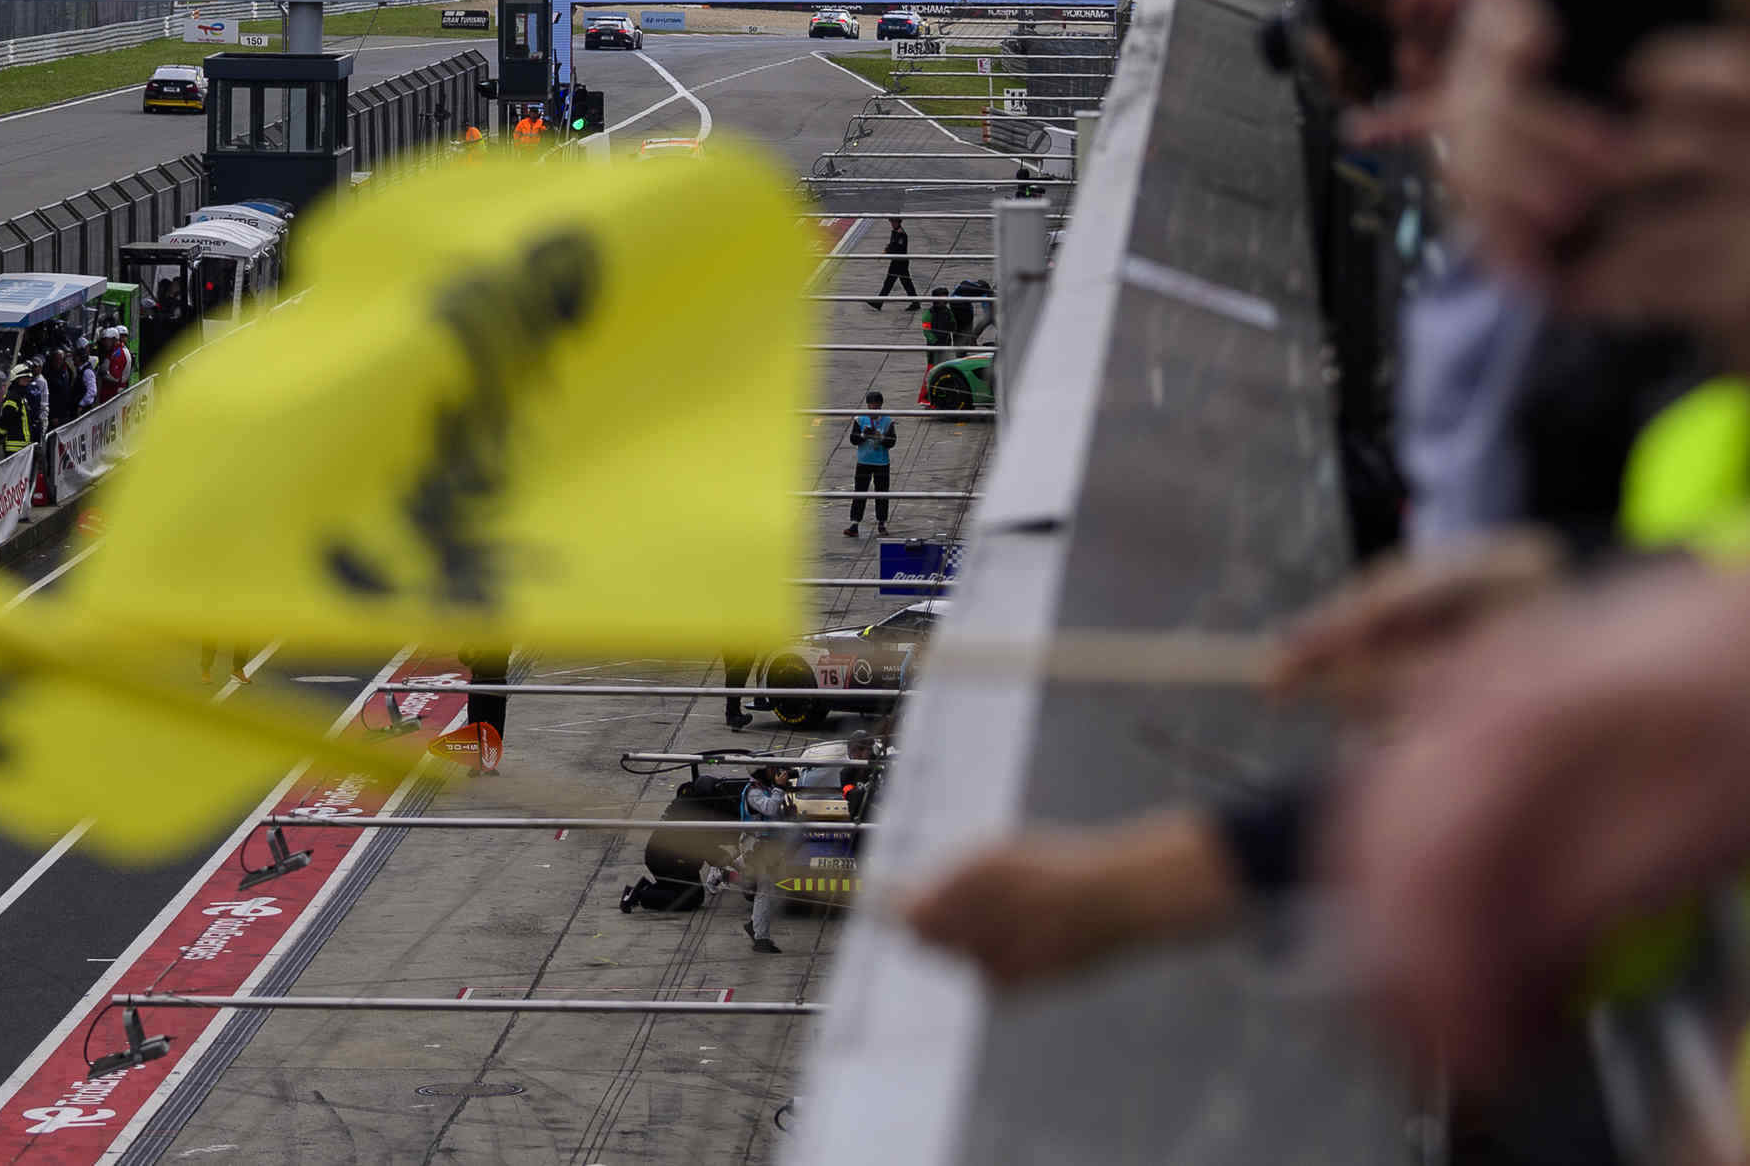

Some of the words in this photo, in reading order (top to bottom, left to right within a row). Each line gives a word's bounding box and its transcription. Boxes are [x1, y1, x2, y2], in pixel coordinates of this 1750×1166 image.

[246, 36, 263, 46] 150
[181, 237, 228, 247] MANTHEY
[821, 669, 838, 685] 76
